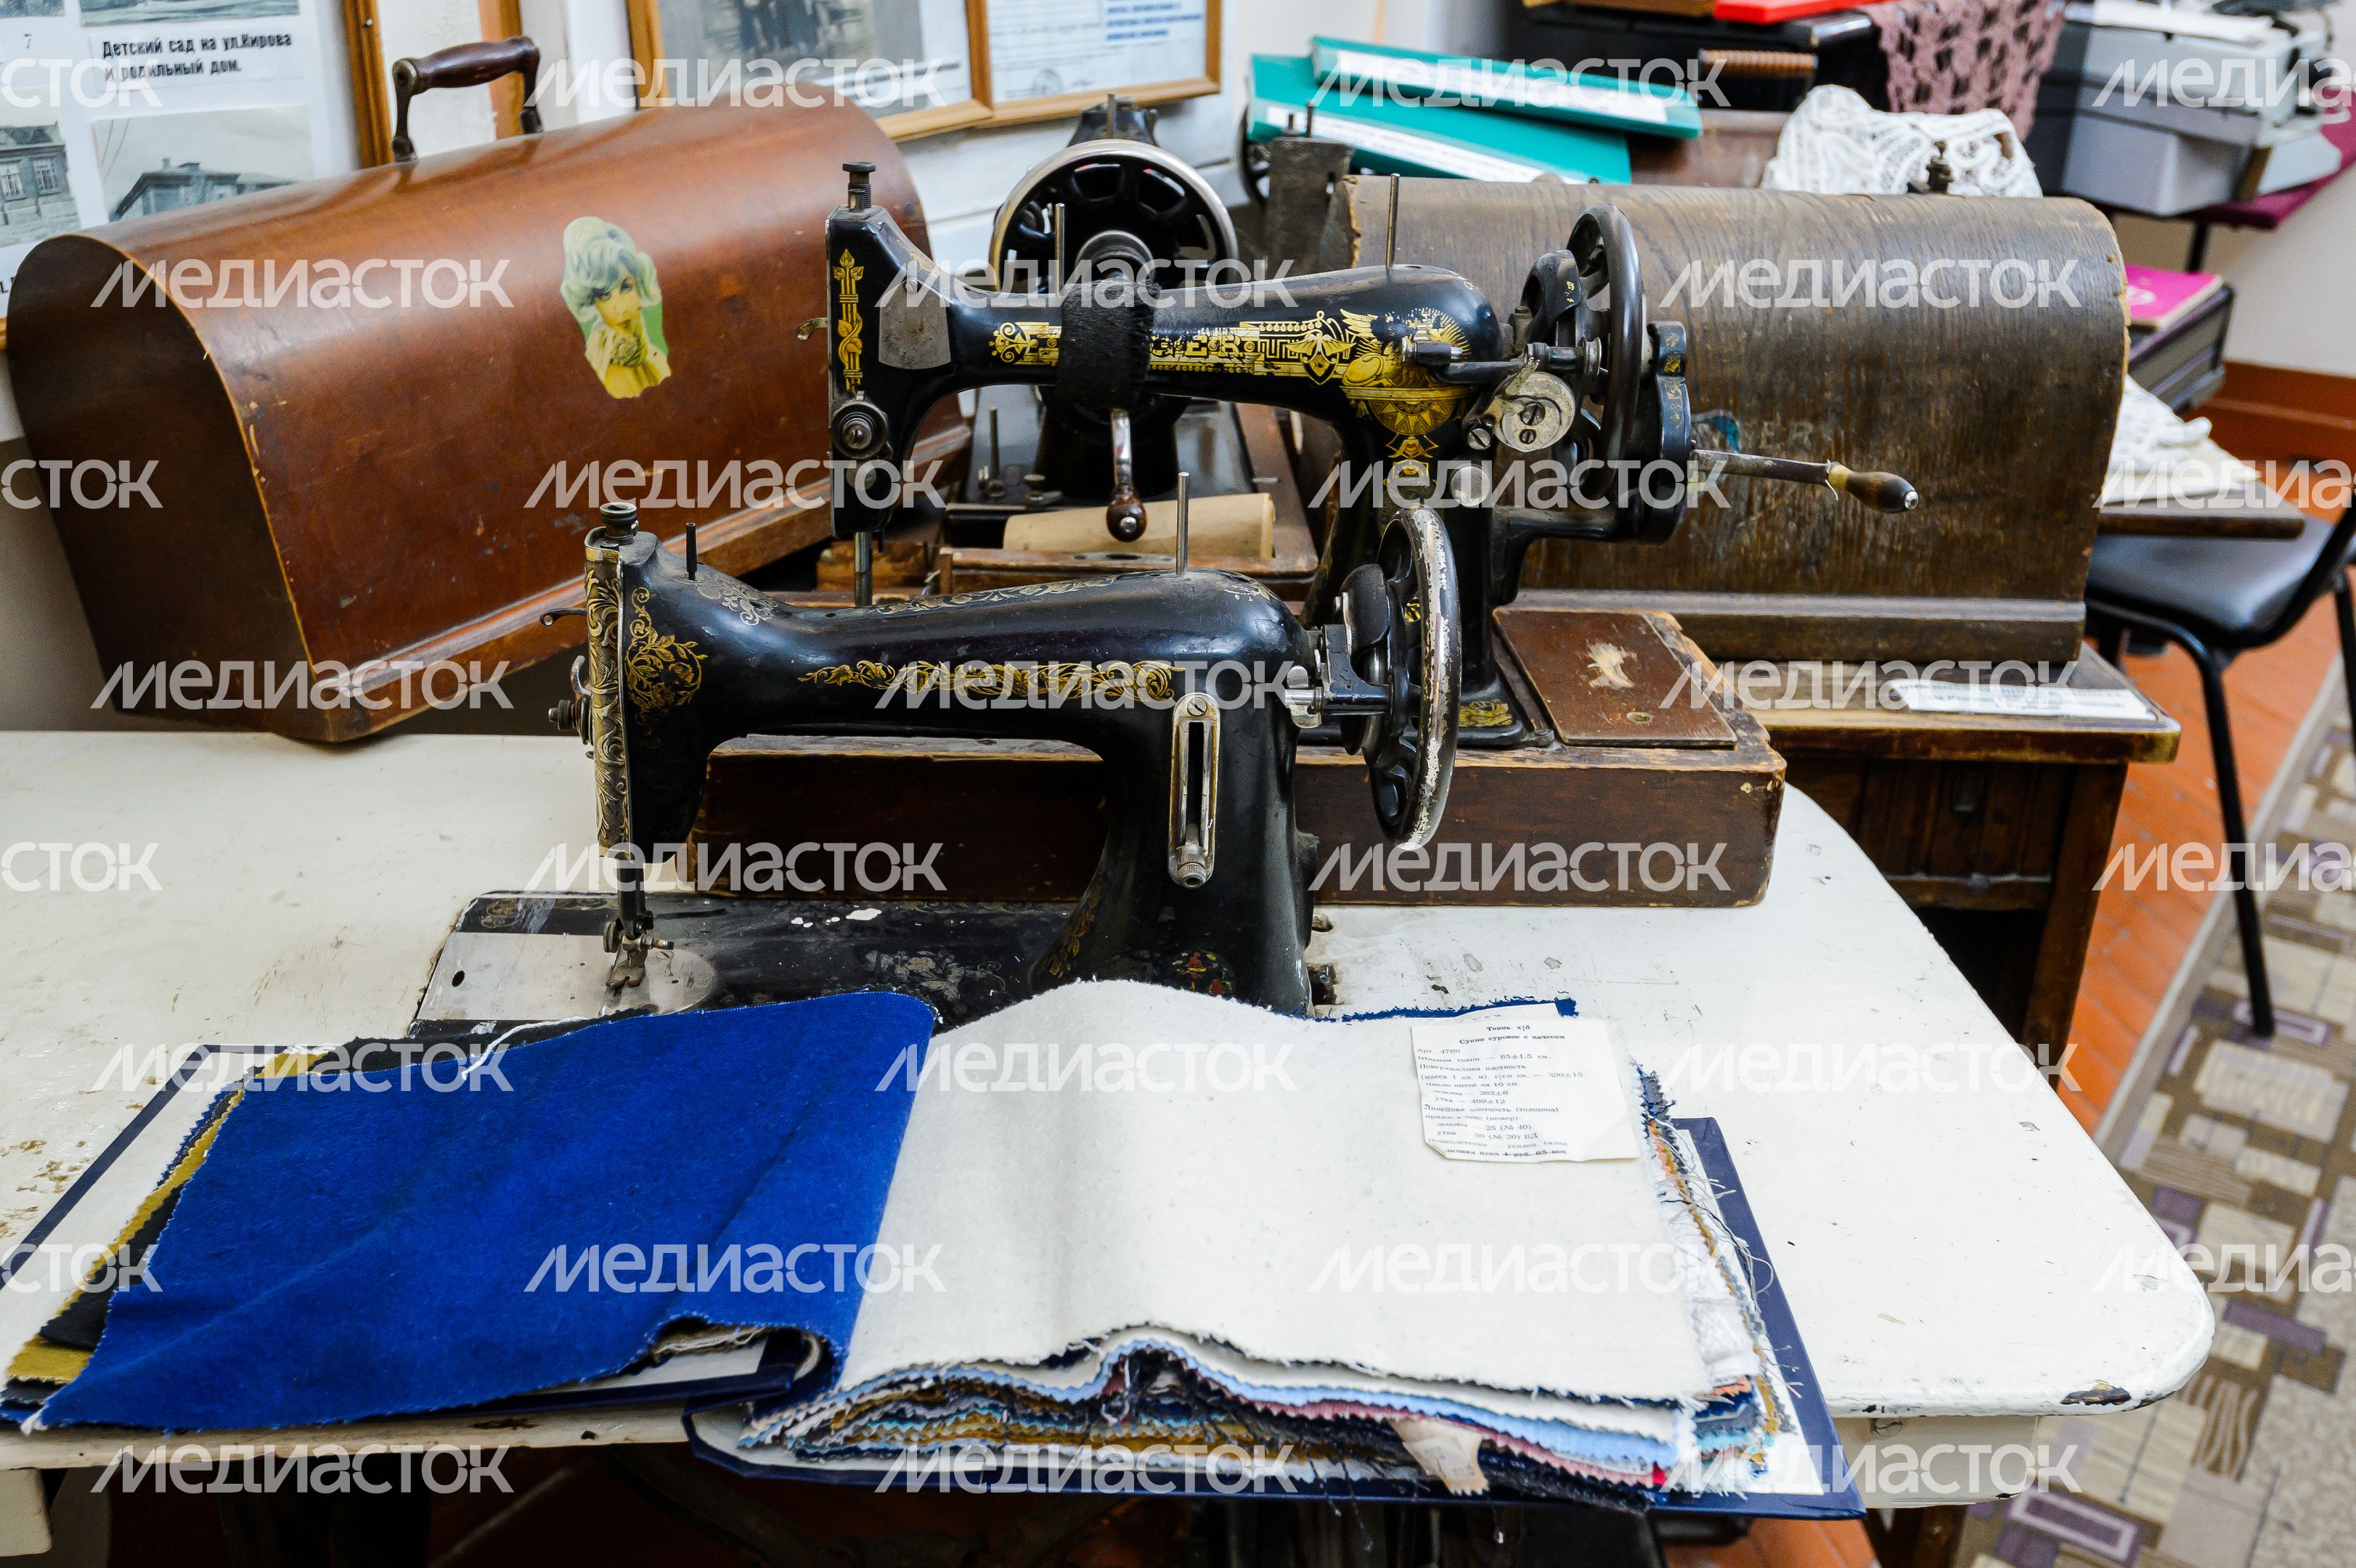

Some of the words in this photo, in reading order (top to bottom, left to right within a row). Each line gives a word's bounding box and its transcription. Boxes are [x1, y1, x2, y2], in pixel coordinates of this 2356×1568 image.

[102, 38, 163, 58] Детский
[169, 38, 195, 53] сад
[201, 38, 216, 50] на
[1459, 1037, 1485, 1045] Сукно
